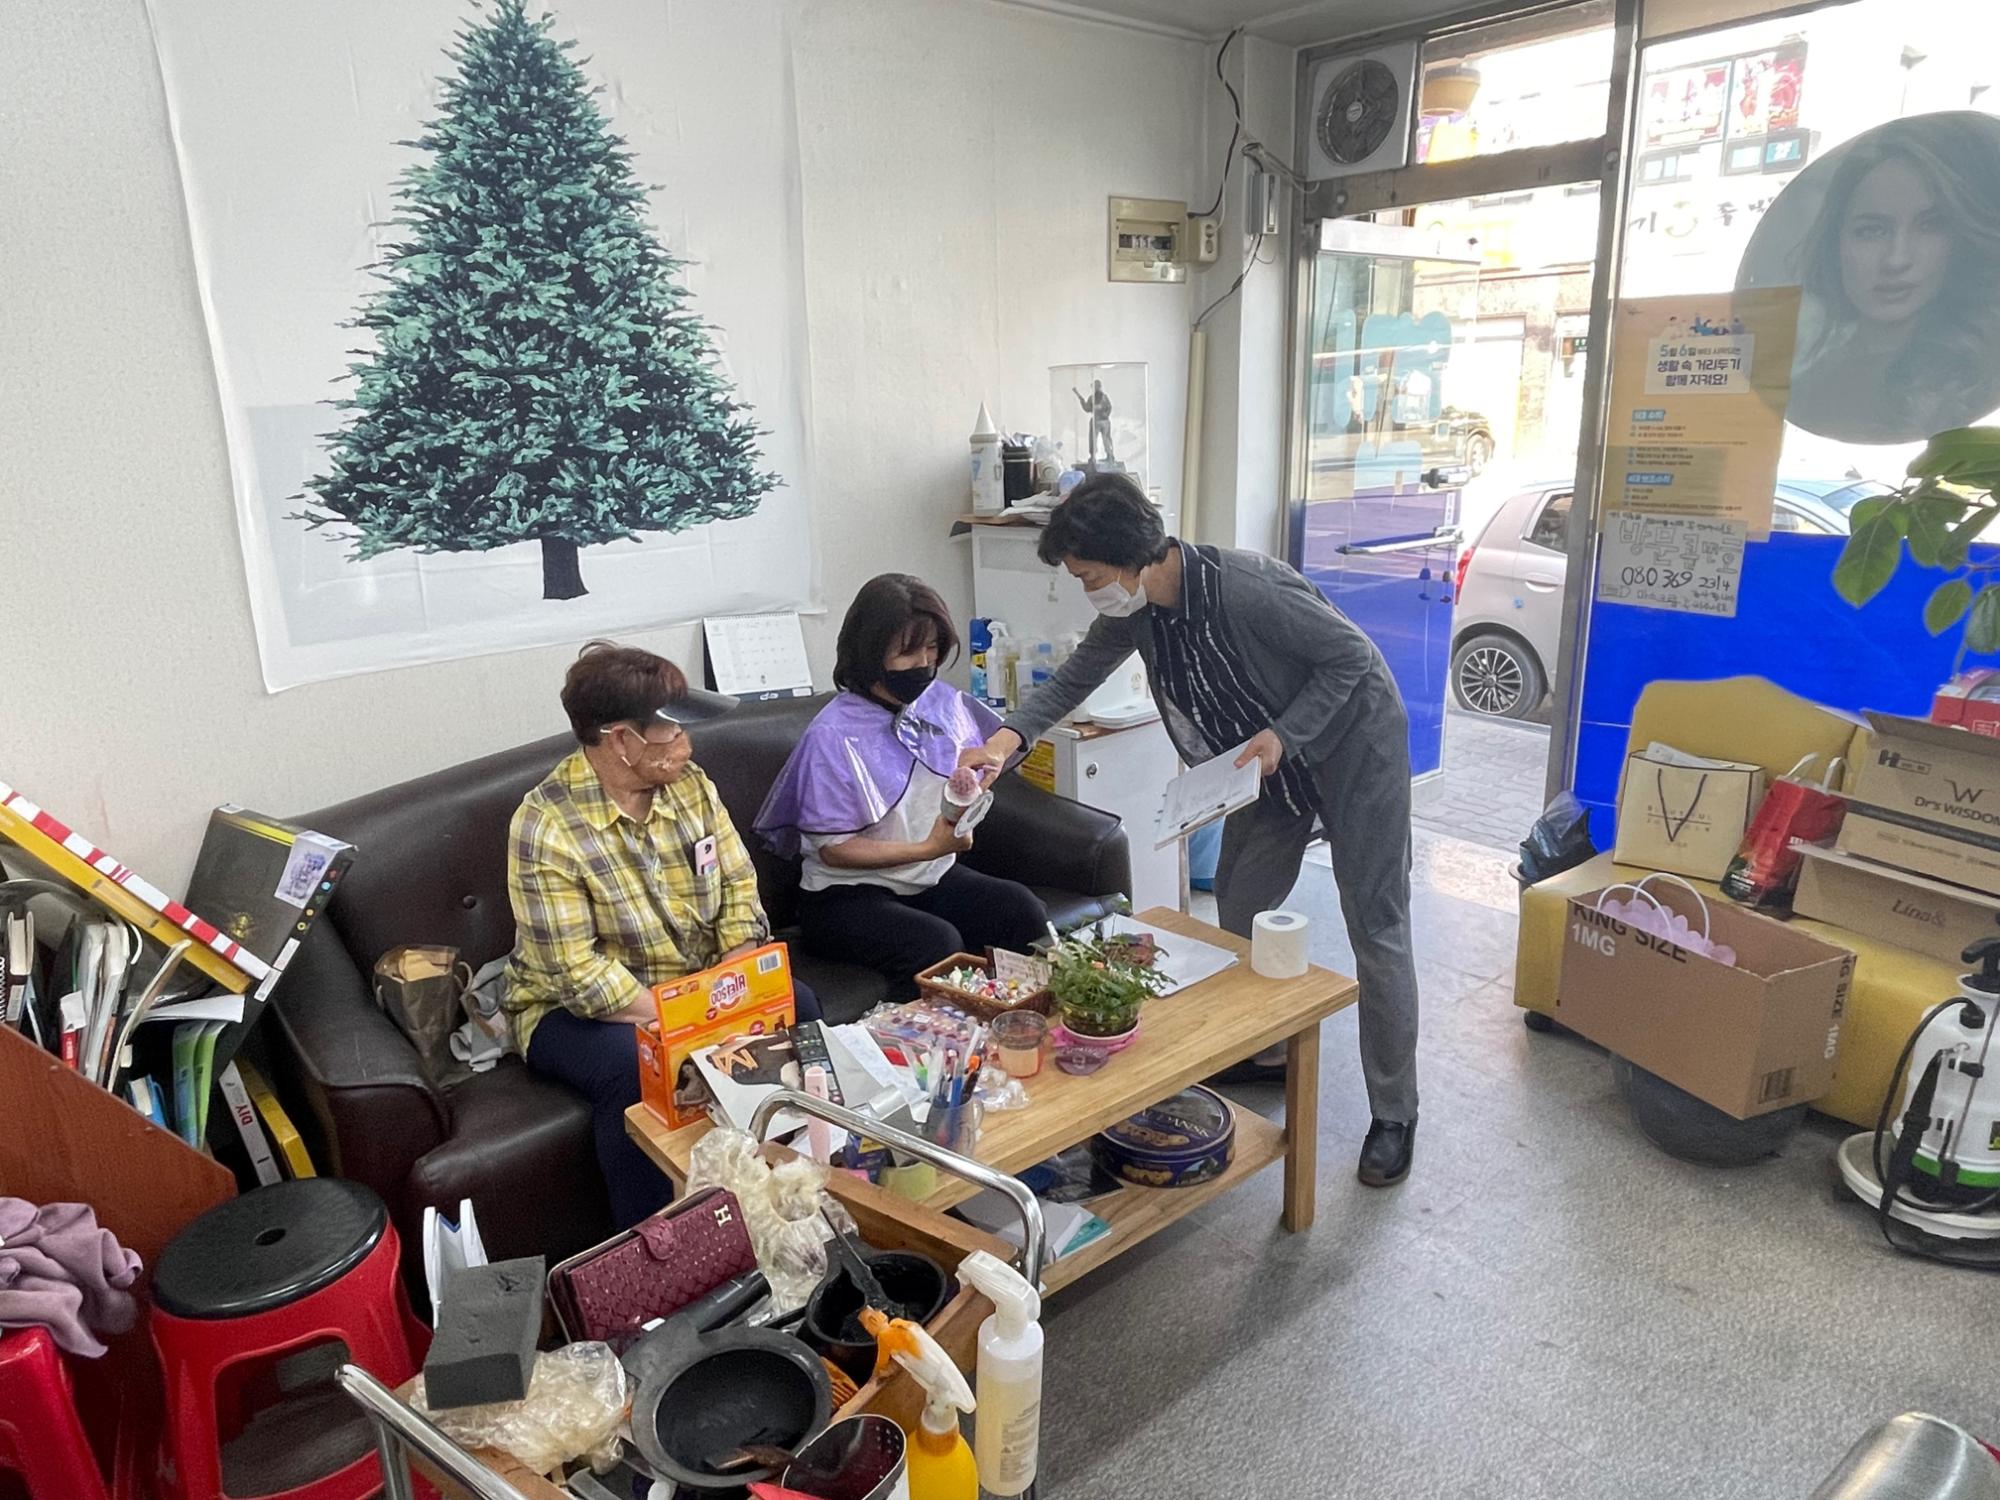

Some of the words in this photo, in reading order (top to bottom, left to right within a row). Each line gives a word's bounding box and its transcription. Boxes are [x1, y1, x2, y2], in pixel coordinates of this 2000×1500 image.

[1657, 360, 1680, 373] 생활
[1681, 360, 1692, 371] 속
[1695, 358, 1741, 371] 거리두기
[1689, 373, 1728, 386] 지켜요!
[1621, 566, 1659, 587] 080
[1662, 569, 1694, 589] 369
[1698, 575, 1731, 592] 2314
[1572, 923, 1616, 957] 1MG
[235, 1104, 253, 1126] DIY
